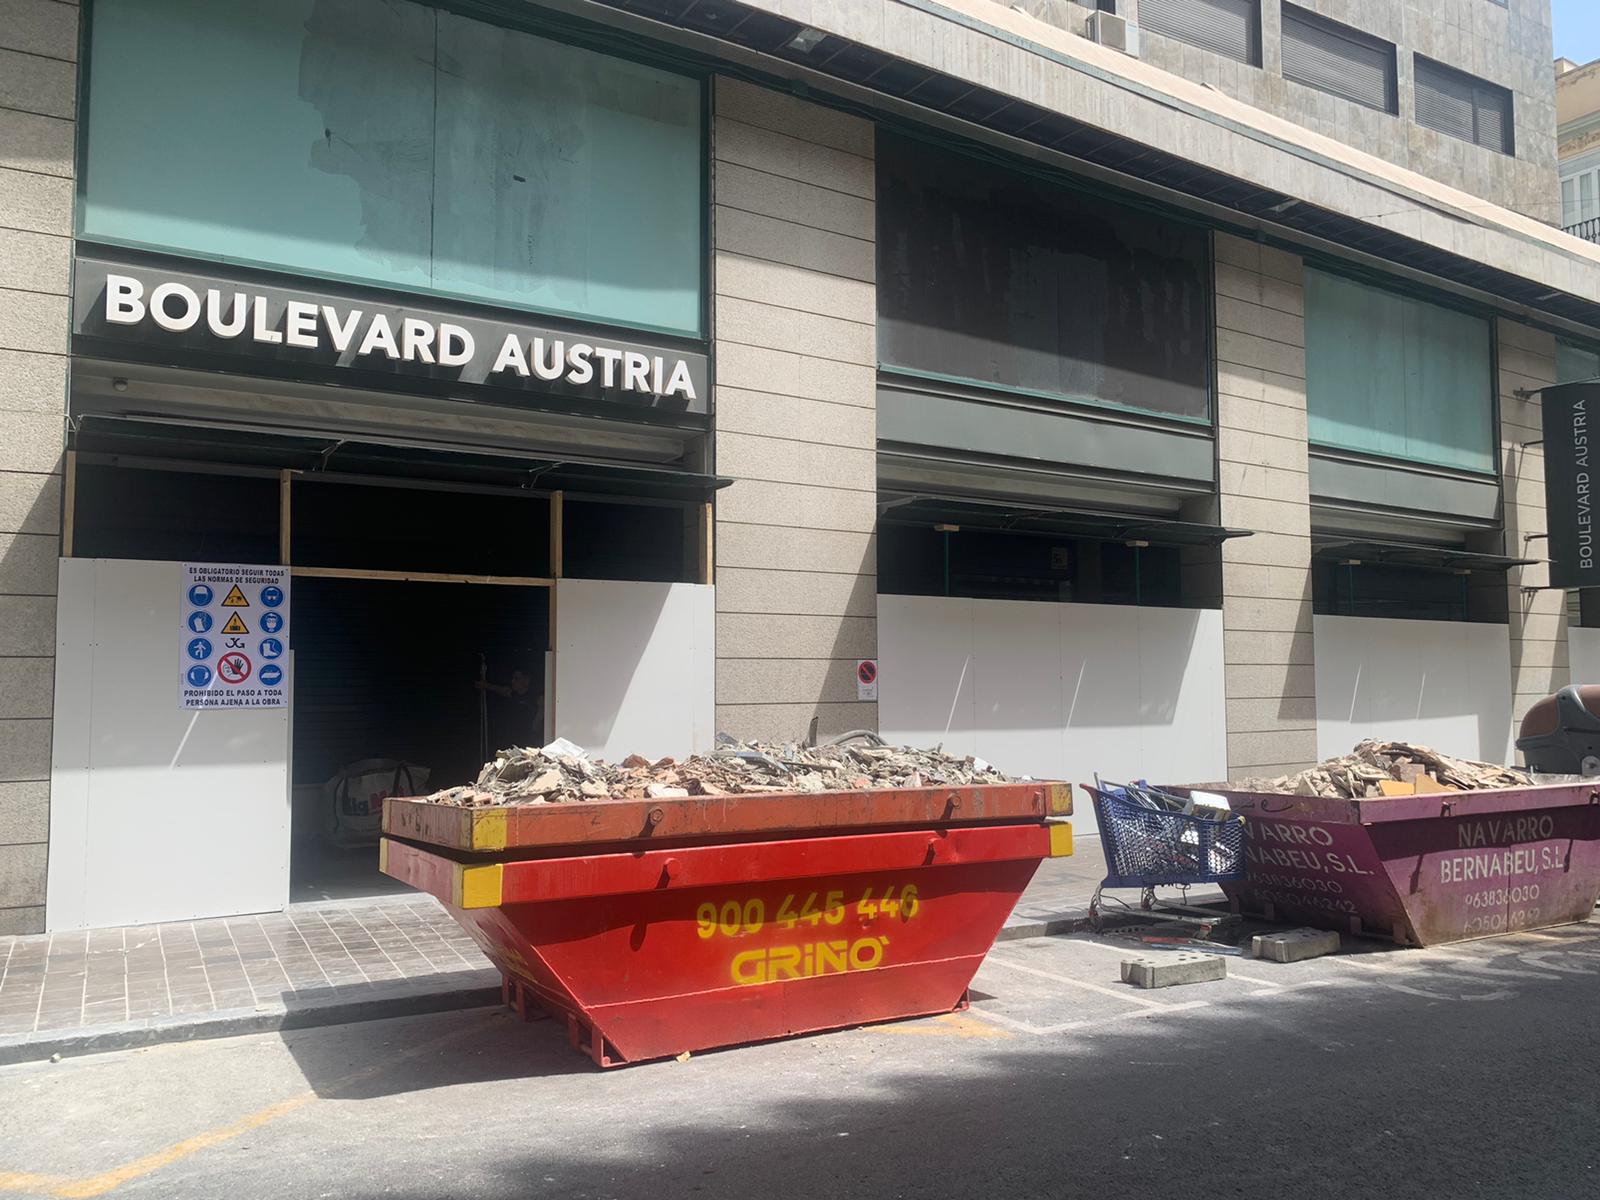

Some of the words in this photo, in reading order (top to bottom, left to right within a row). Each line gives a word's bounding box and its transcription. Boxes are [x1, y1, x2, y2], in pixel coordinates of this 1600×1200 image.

[106, 274, 475, 367] BOULEVARD
[492, 333, 697, 399] AUSTRIA
[1573, 399, 1589, 467] AUSTRIA
[1576, 472, 1593, 569] BOULEVARD
[201, 567, 240, 575] OBLIGATORIO
[241, 568, 264, 576] SEGUIR
[265, 569, 285, 577] TODAS
[184, 689, 224, 697] PROHIBIDO
[262, 698, 281, 706] OBRA
[1243, 821, 1333, 847] VARRO
[1457, 815, 1554, 848] NAVARRO
[696, 899, 765, 939] 900
[776, 890, 845, 929] 445
[857, 883, 919, 920] 446
